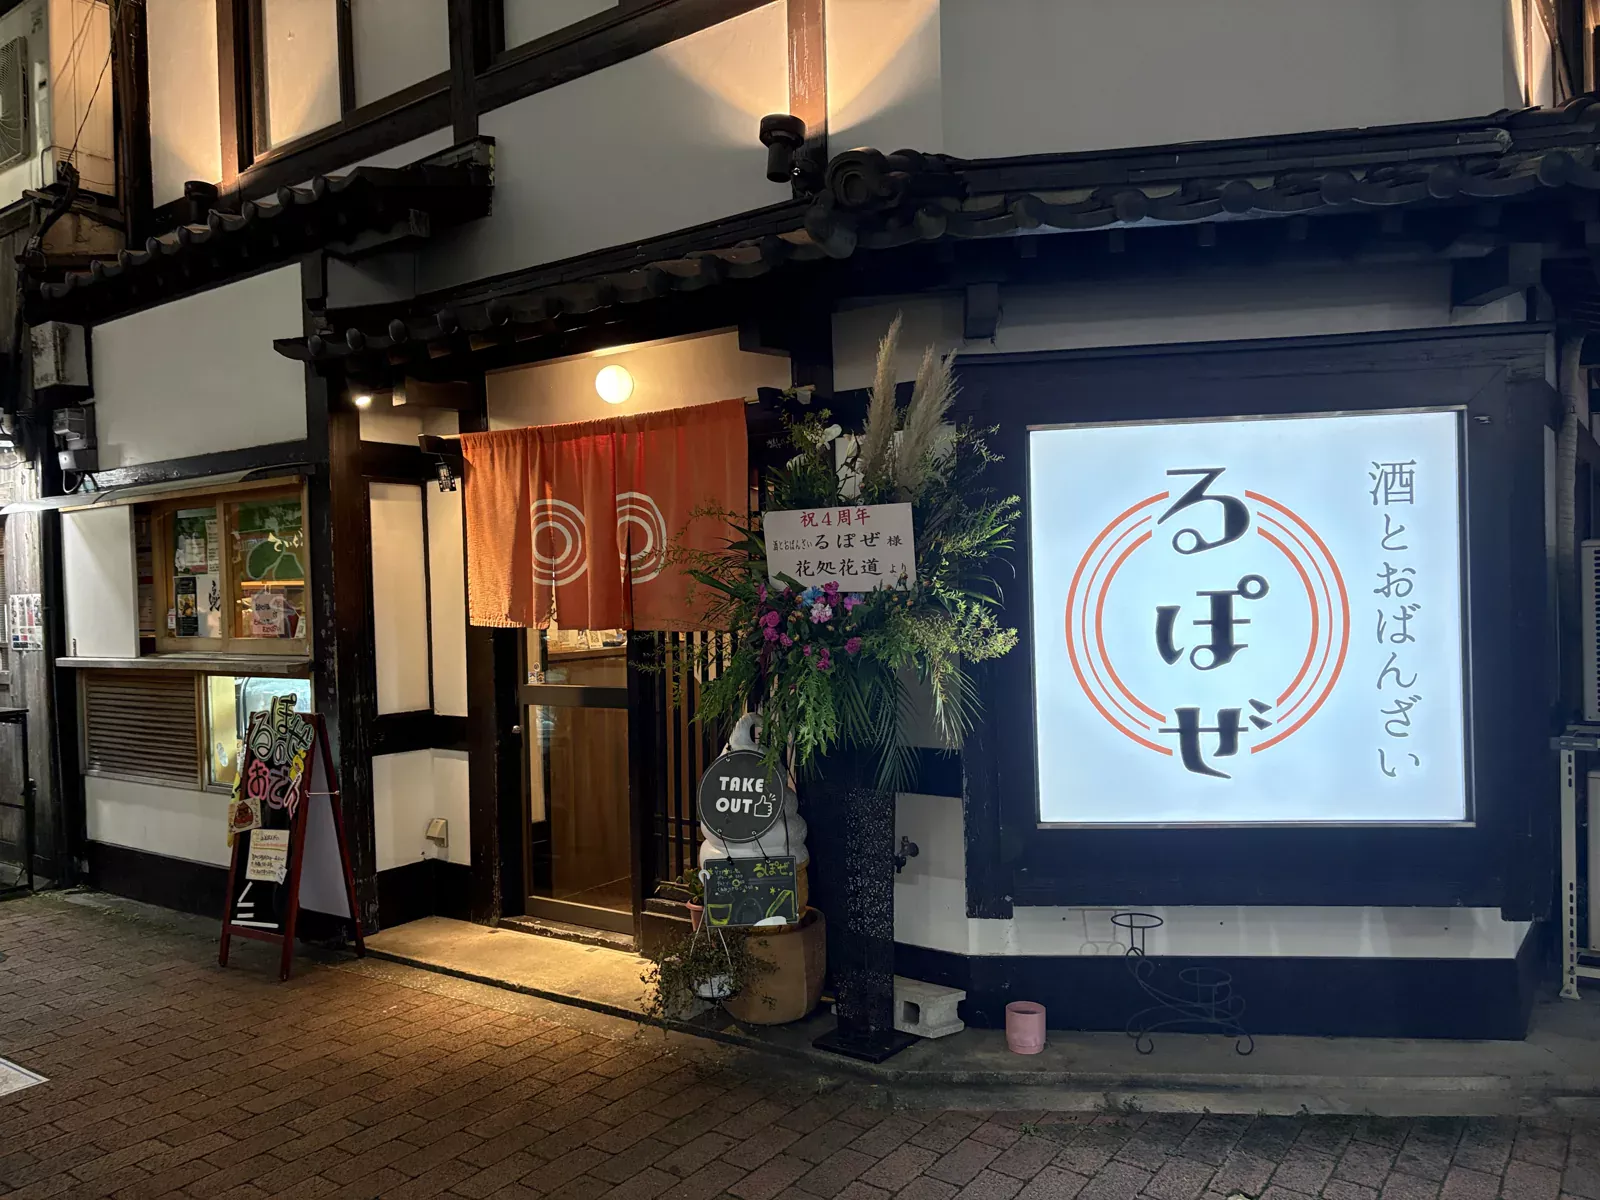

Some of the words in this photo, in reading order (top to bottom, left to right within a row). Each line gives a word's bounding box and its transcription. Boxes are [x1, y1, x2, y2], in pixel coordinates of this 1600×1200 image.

[1157, 467, 1273, 779] るぽぜ
[1369, 458, 1421, 778] 酒とおばんざい
[715, 797, 753, 814] OUT
[719, 776, 764, 793] TAKE
